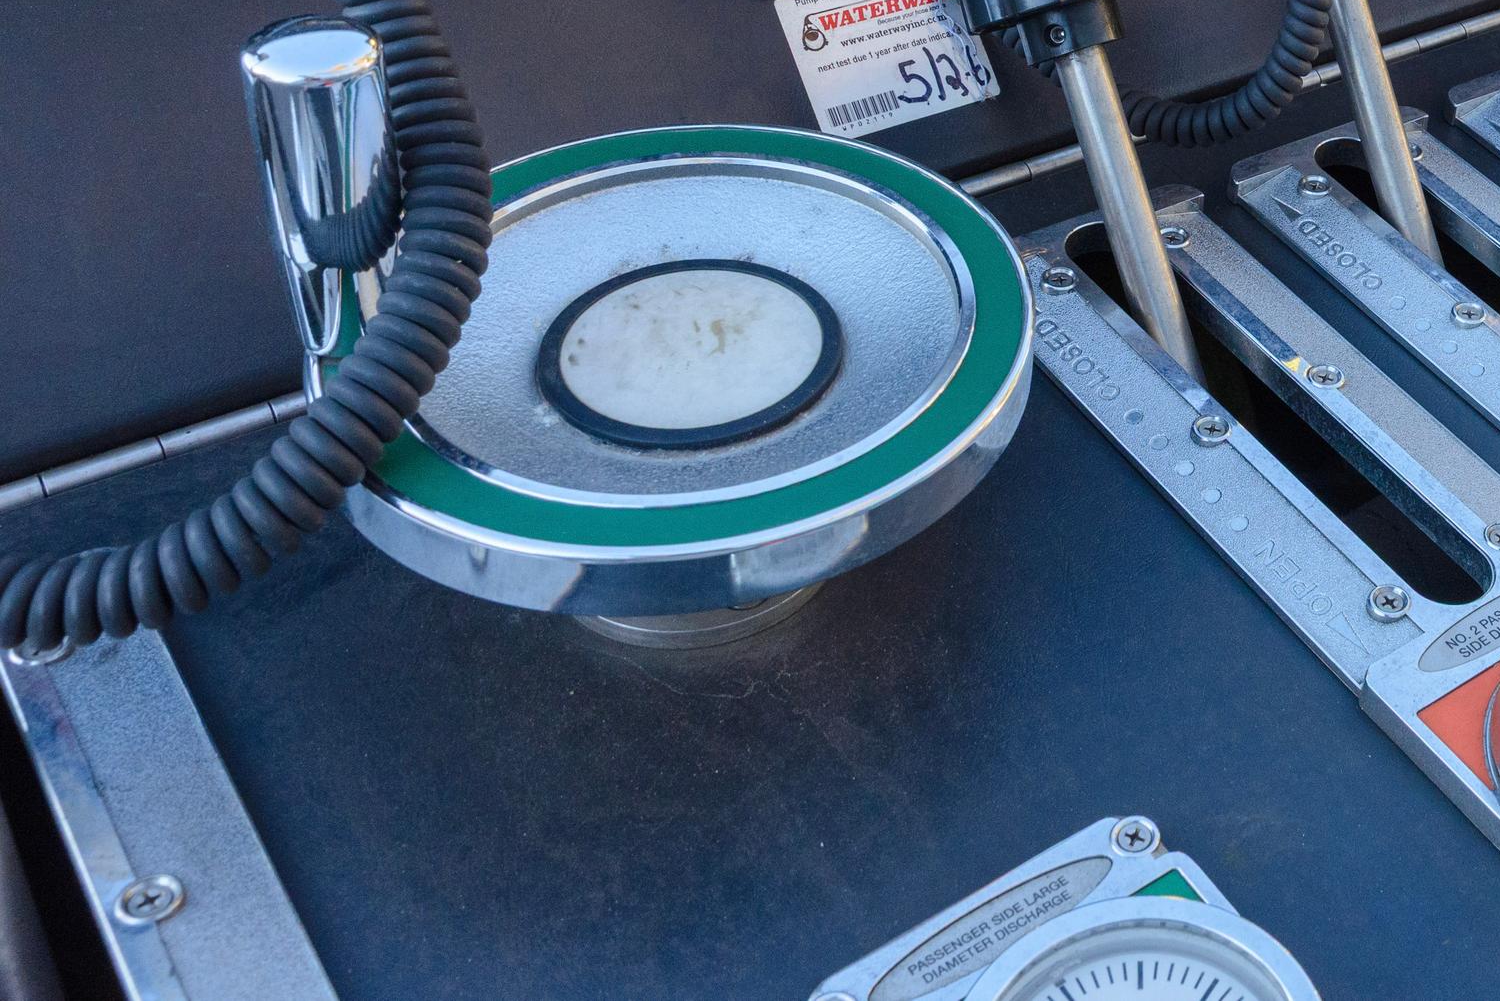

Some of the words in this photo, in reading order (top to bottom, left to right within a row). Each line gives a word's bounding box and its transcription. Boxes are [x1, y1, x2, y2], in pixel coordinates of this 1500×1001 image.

[876, 13, 902, 26] Because
[902, 10, 915, 21] your
[818, 61, 836, 73] next
[836, 57, 852, 68] test
[852, 53, 869, 64] due
[874, 46, 892, 59] year
[892, 41, 910, 53] after
[911, 37, 928, 49] date
[1299, 218, 1383, 290] CLOSED
[1035, 317, 1121, 401] CLOSED
[1254, 539, 1334, 615] OPEN
[1445, 632, 1470, 651] NO.
[1458, 635, 1491, 659] SIDE
[906, 921, 992, 978] PASSENGER
[991, 900, 1023, 929] SIDE
[1022, 874, 1070, 909] LARGE
[922, 935, 995, 986] DIAMETER
[992, 889, 1073, 943] DISCHARGE
